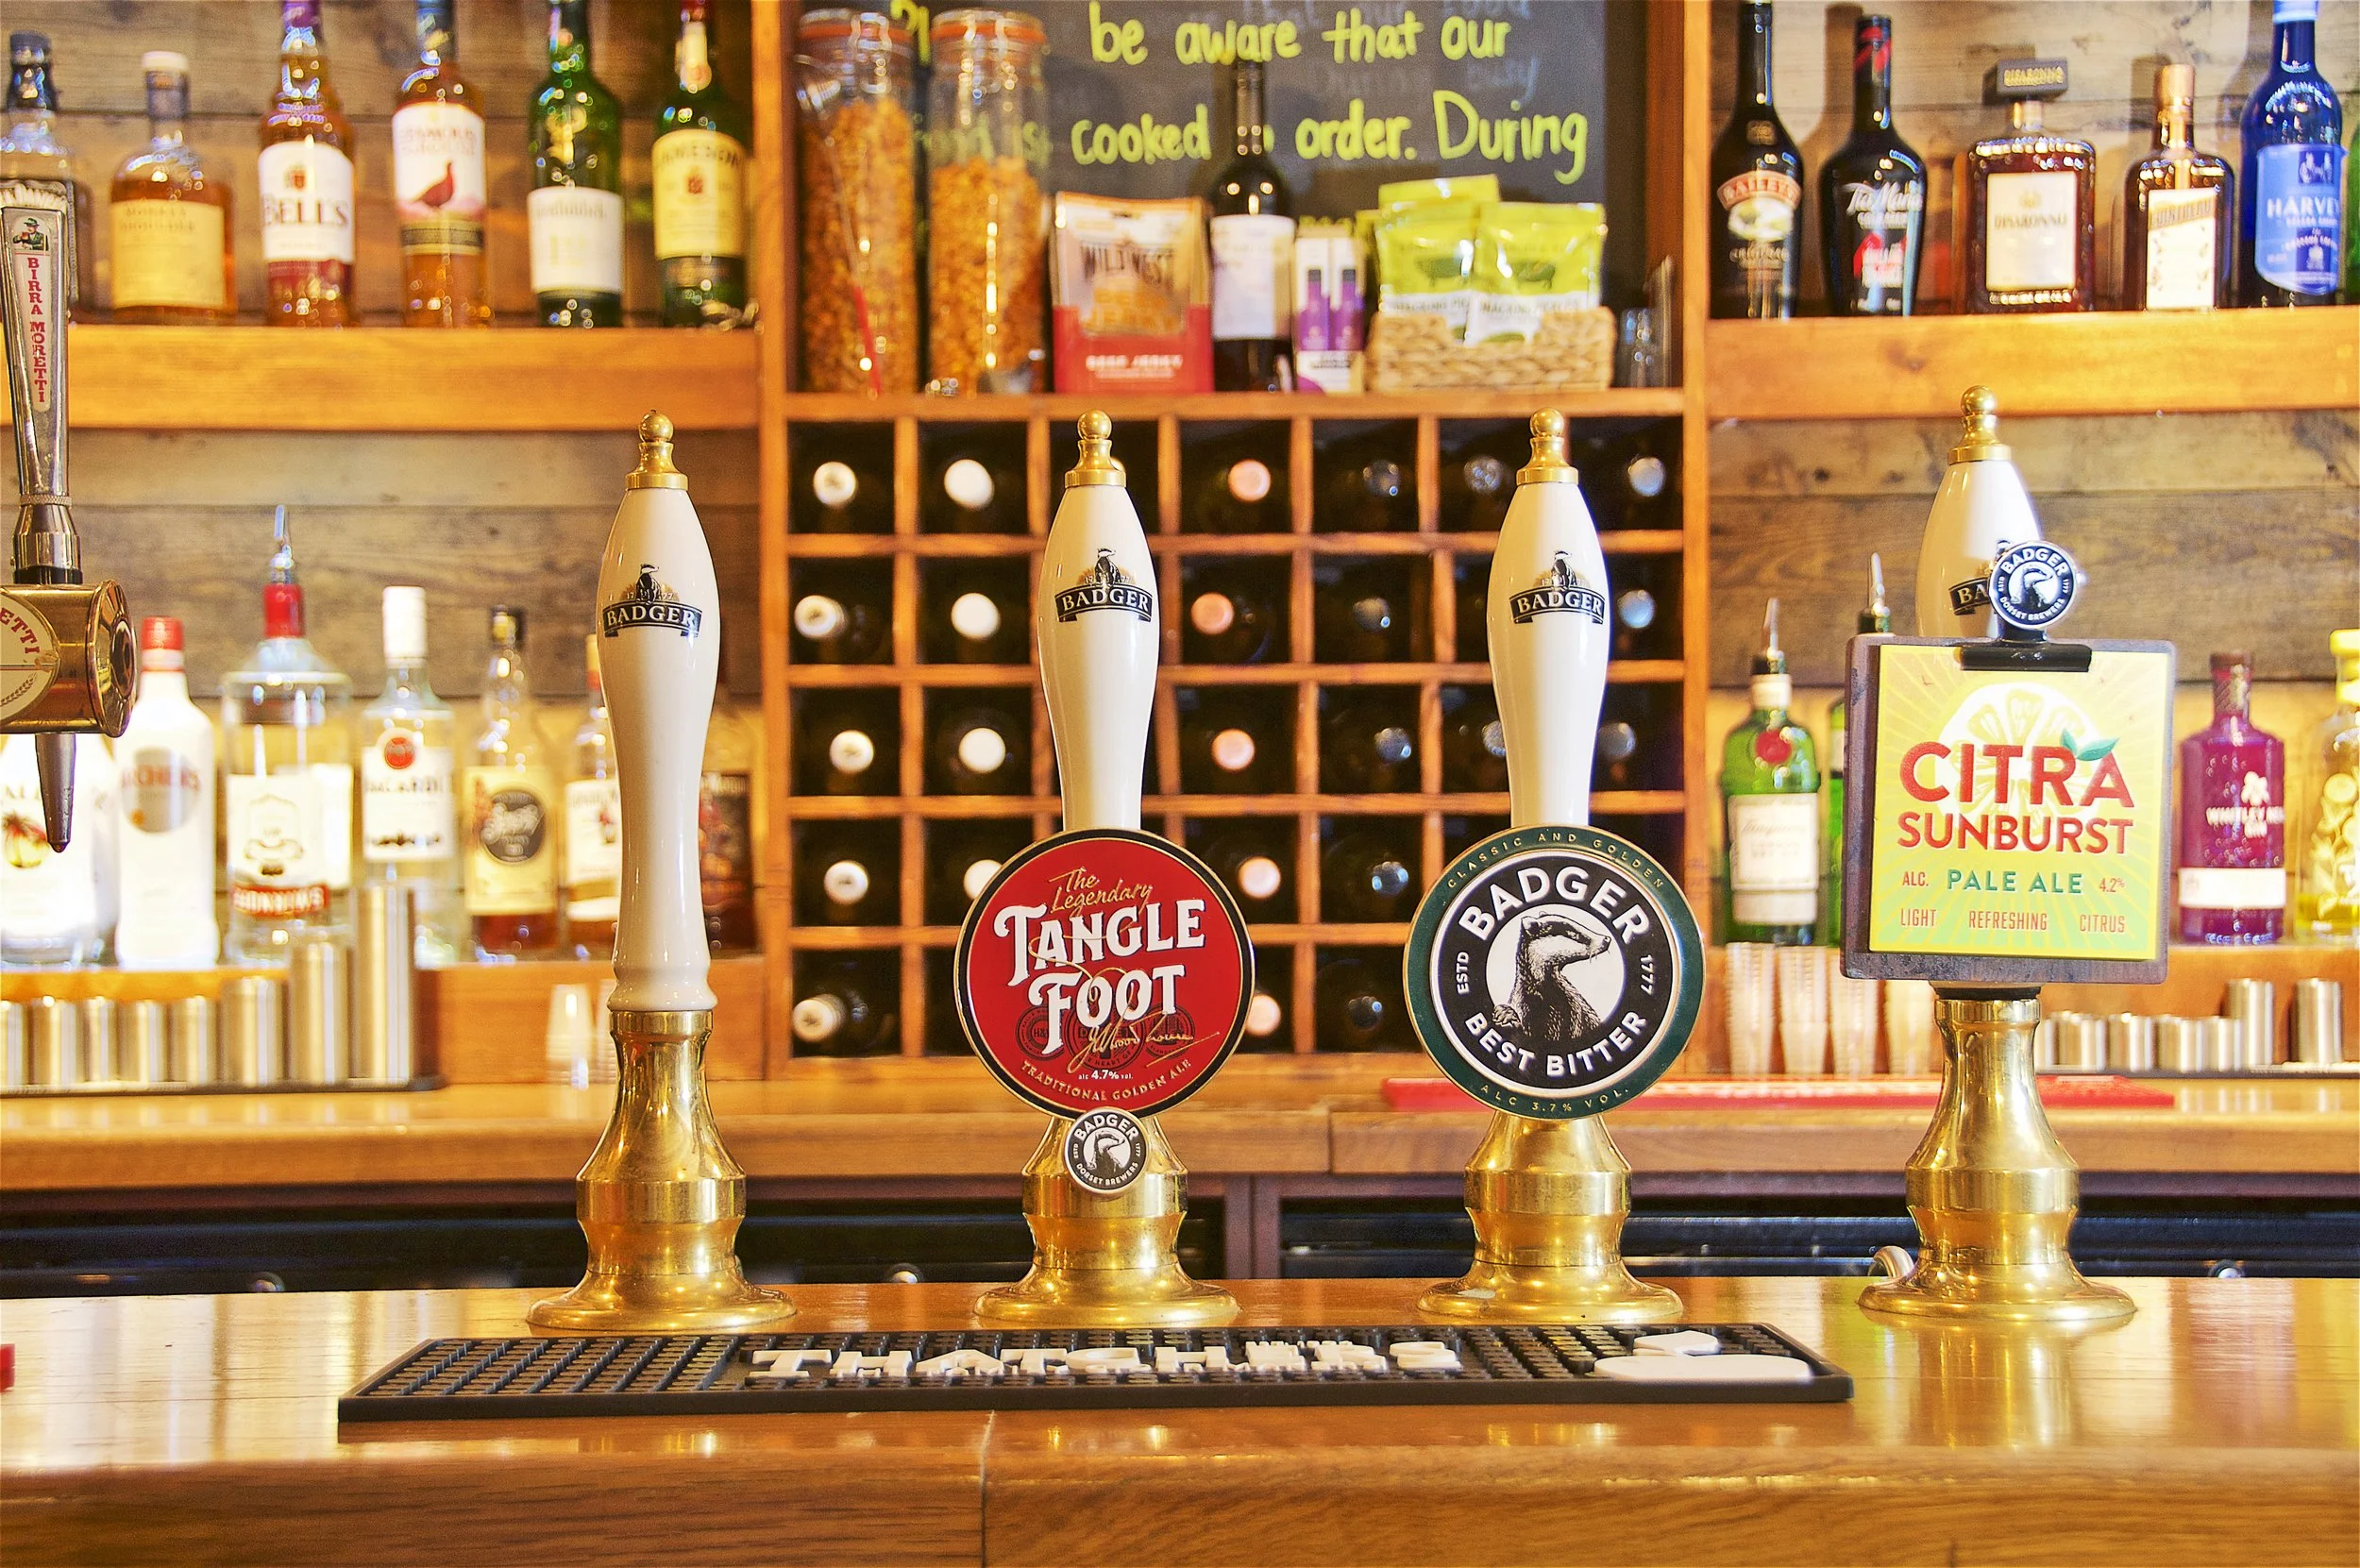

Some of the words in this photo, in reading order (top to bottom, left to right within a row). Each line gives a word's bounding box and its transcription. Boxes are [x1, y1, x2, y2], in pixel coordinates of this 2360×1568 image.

[1089, 2, 1148, 65] be
[1175, 19, 1302, 64] aware
[1322, 8, 1424, 64] that
[1441, 15, 1511, 60] our
[1070, 103, 1212, 165] cooked
[1295, 98, 1417, 160] order.
[1433, 90, 1588, 185] During
[27, 257, 43, 315] BIRRA
[29, 321, 48, 403] MORETTI
[1999, 548, 2070, 577] BADGER
[607, 605, 696, 628] BADGER
[1061, 587, 1149, 612] BADGER
[1516, 591, 1603, 616] BADGER
[0, 607, 40, 654] ETTI
[1899, 742, 2135, 808] CITRA
[1896, 811, 2133, 854] SUNBURST
[1049, 866, 1101, 893] The
[1447, 836, 1523, 889] CLASSIC
[1538, 832, 1577, 843] AND
[1593, 838, 1664, 888] GOLDEN
[1902, 870, 1930, 887] ALC.
[1947, 868, 2016, 892] PALE
[2029, 872, 2082, 894] ALE
[2099, 877, 2125, 893] 4.2%
[1050, 879, 1154, 919] Legendary
[1458, 866, 1650, 944] BADGER
[1900, 908, 1937, 928] LIGHT
[1969, 910, 2048, 931] REFRESHING
[2080, 914, 2125, 933] CITRUS
[994, 900, 1206, 987] TANGLE
[1457, 952, 1470, 994] ESTD
[1640, 953, 1655, 995] 1777
[1028, 964, 1187, 1056] FOOT
[1465, 1012, 1536, 1072] BEST
[1546, 1010, 1647, 1078] BITTER
[1020, 1060, 1107, 1102] TRADITIONAL
[1112, 1074, 1167, 1102] GOLDEN
[1169, 1058, 1192, 1080] ALE
[1090, 1069, 1120, 1081] 4.7%
[1480, 1083, 1517, 1105] ALC
[1531, 1101, 1572, 1112] 3.7%
[1584, 1087, 1628, 1108] VOL.
[1073, 1114, 1139, 1141] BADGER
[1076, 1163, 1104, 1185] DORSET
[1104, 1162, 1138, 1186] BREWERS
